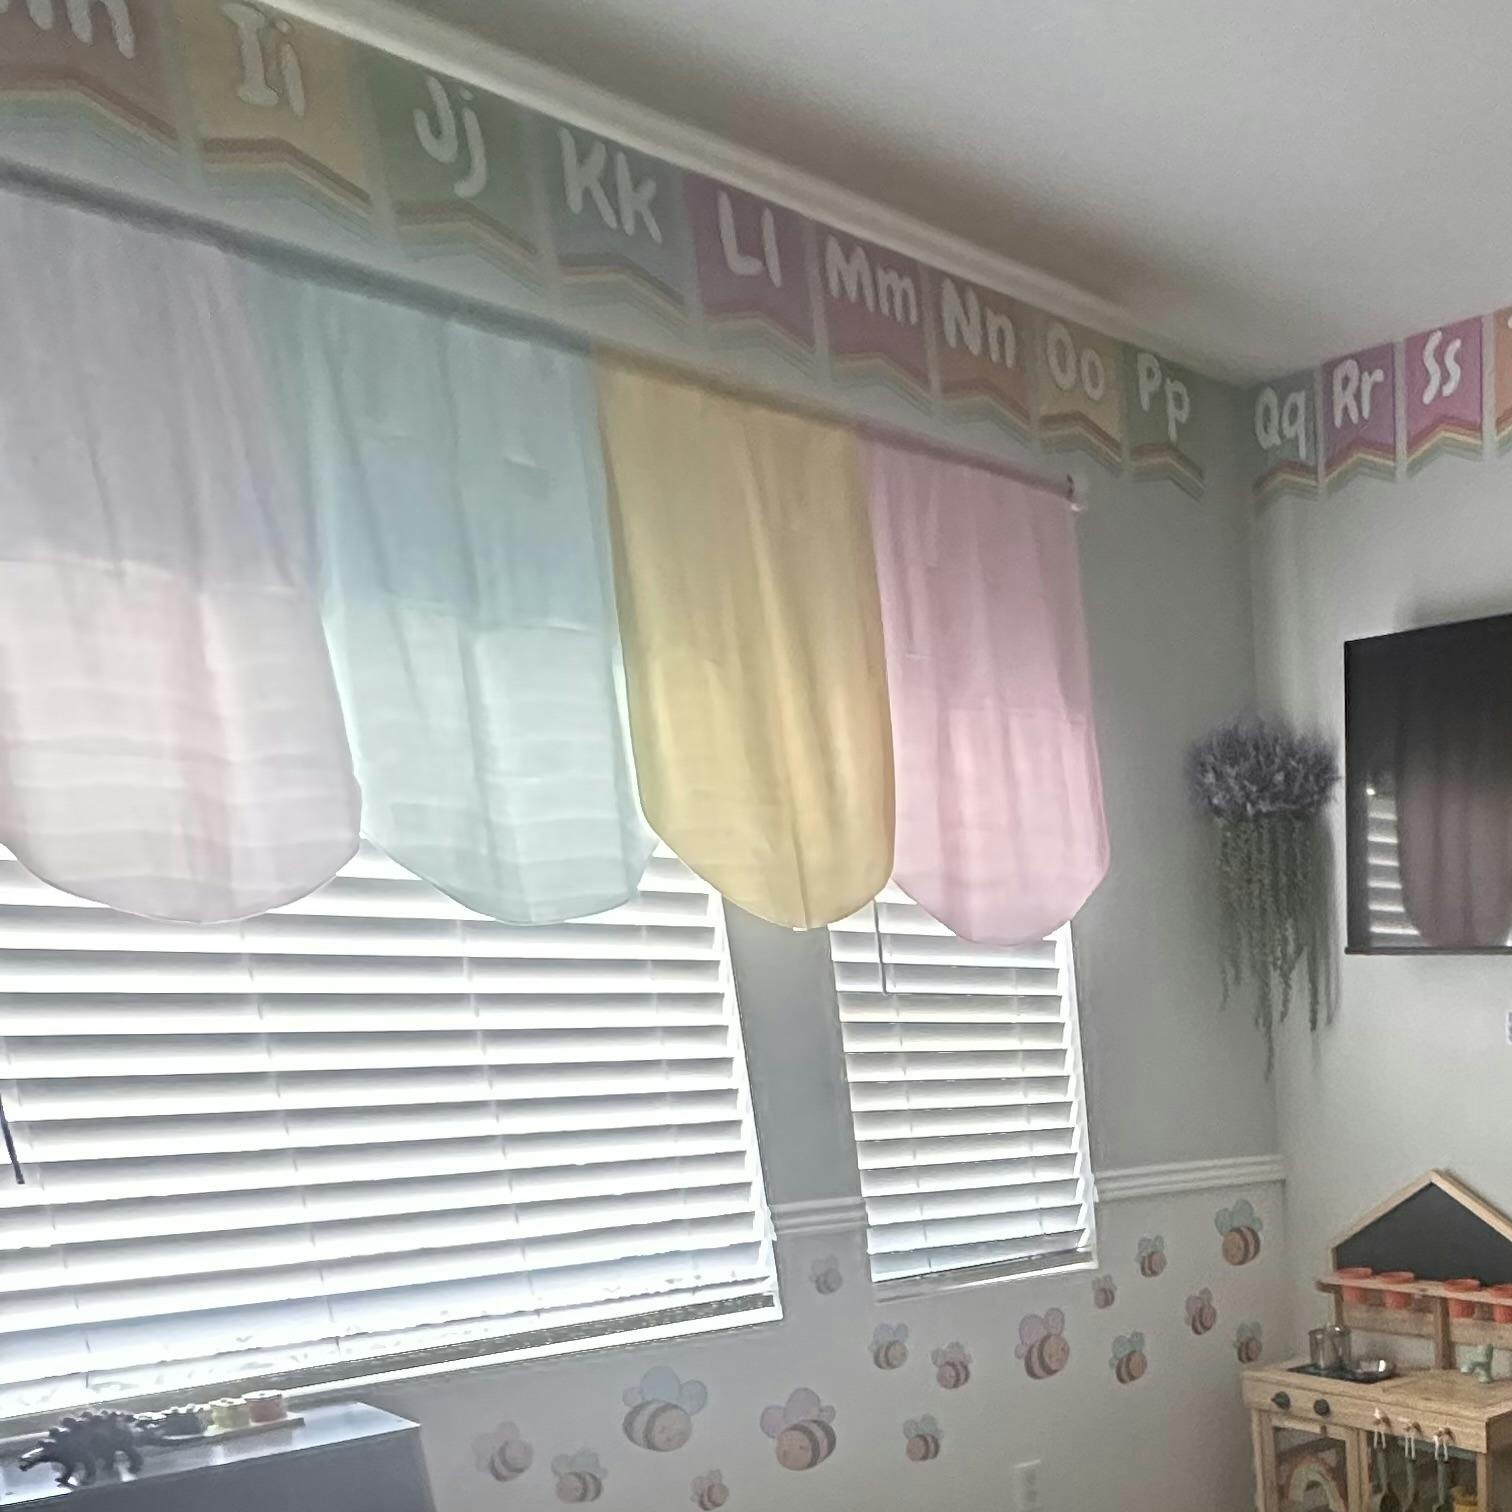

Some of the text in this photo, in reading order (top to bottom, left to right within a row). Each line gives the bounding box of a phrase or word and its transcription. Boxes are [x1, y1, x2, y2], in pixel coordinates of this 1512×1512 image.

[221, 3, 305, 117] Ii
[412, 76, 488, 198] Jj
[559, 127, 663, 244] Kk
[716, 191, 783, 288] Ll
[825, 234, 918, 326] Mm
[940, 279, 1016, 369] Nn
[1044, 322, 1106, 401] Oo
[1422, 330, 1463, 405] Ss
[1136, 350, 1191, 442] Pp
[1253, 386, 1308, 461] Qq
[1332, 358, 1385, 429] Rr
